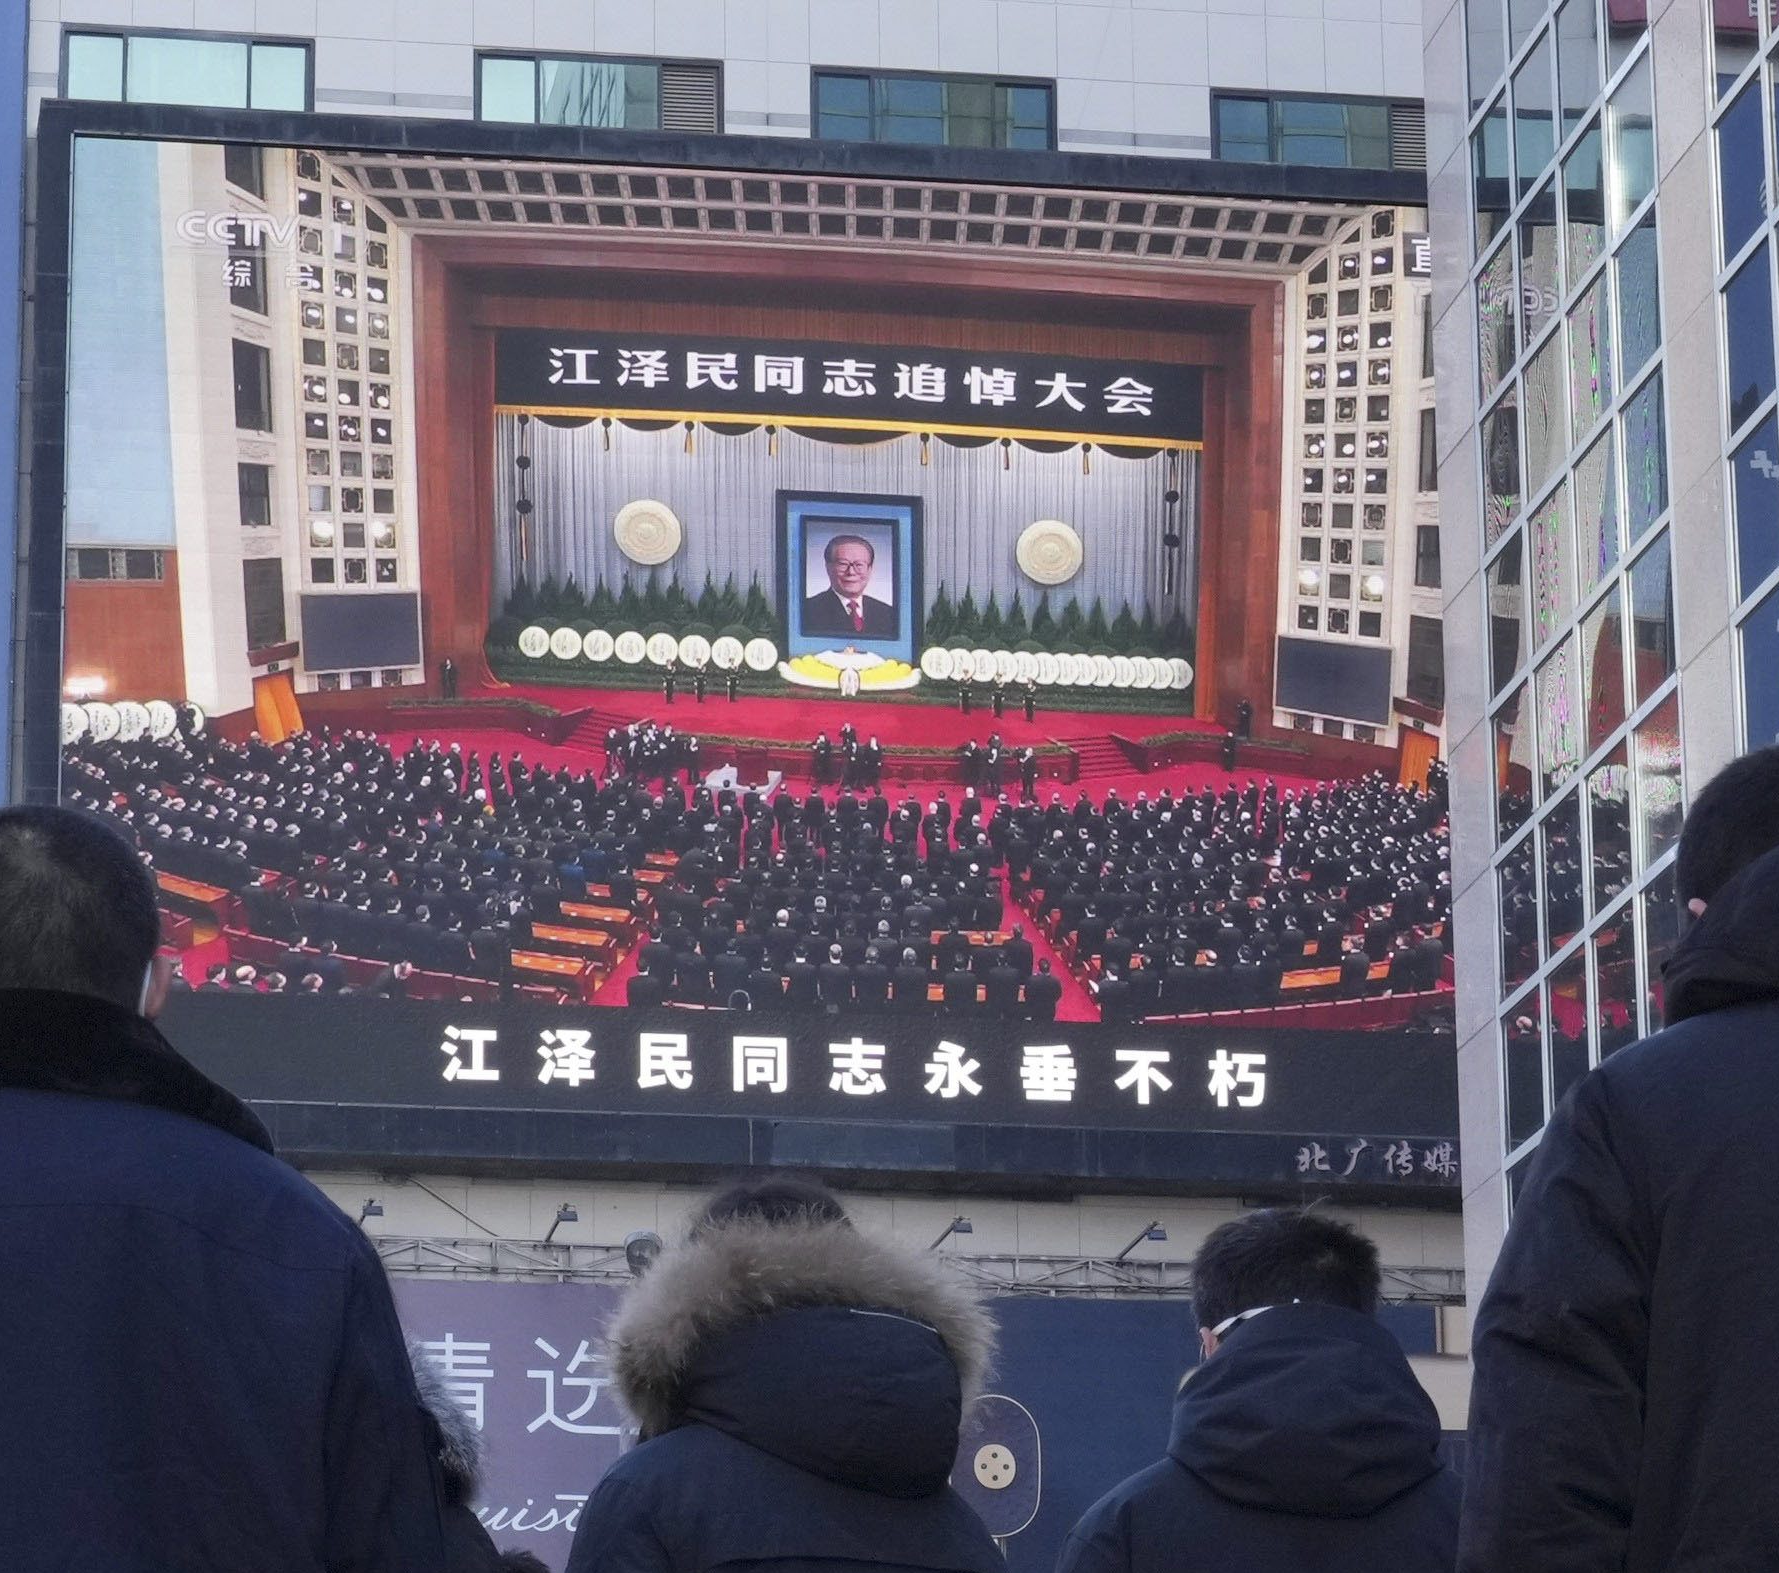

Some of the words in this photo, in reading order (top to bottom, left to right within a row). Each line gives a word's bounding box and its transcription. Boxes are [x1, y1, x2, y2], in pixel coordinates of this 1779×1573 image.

[176, 209, 304, 249] CCTV
[547, 347, 1155, 417] 江泽民同志追悼大会
[440, 1024, 1268, 1108] 江泽民同志永垂不朽
[1295, 1138, 1459, 1178] 北广传媒
